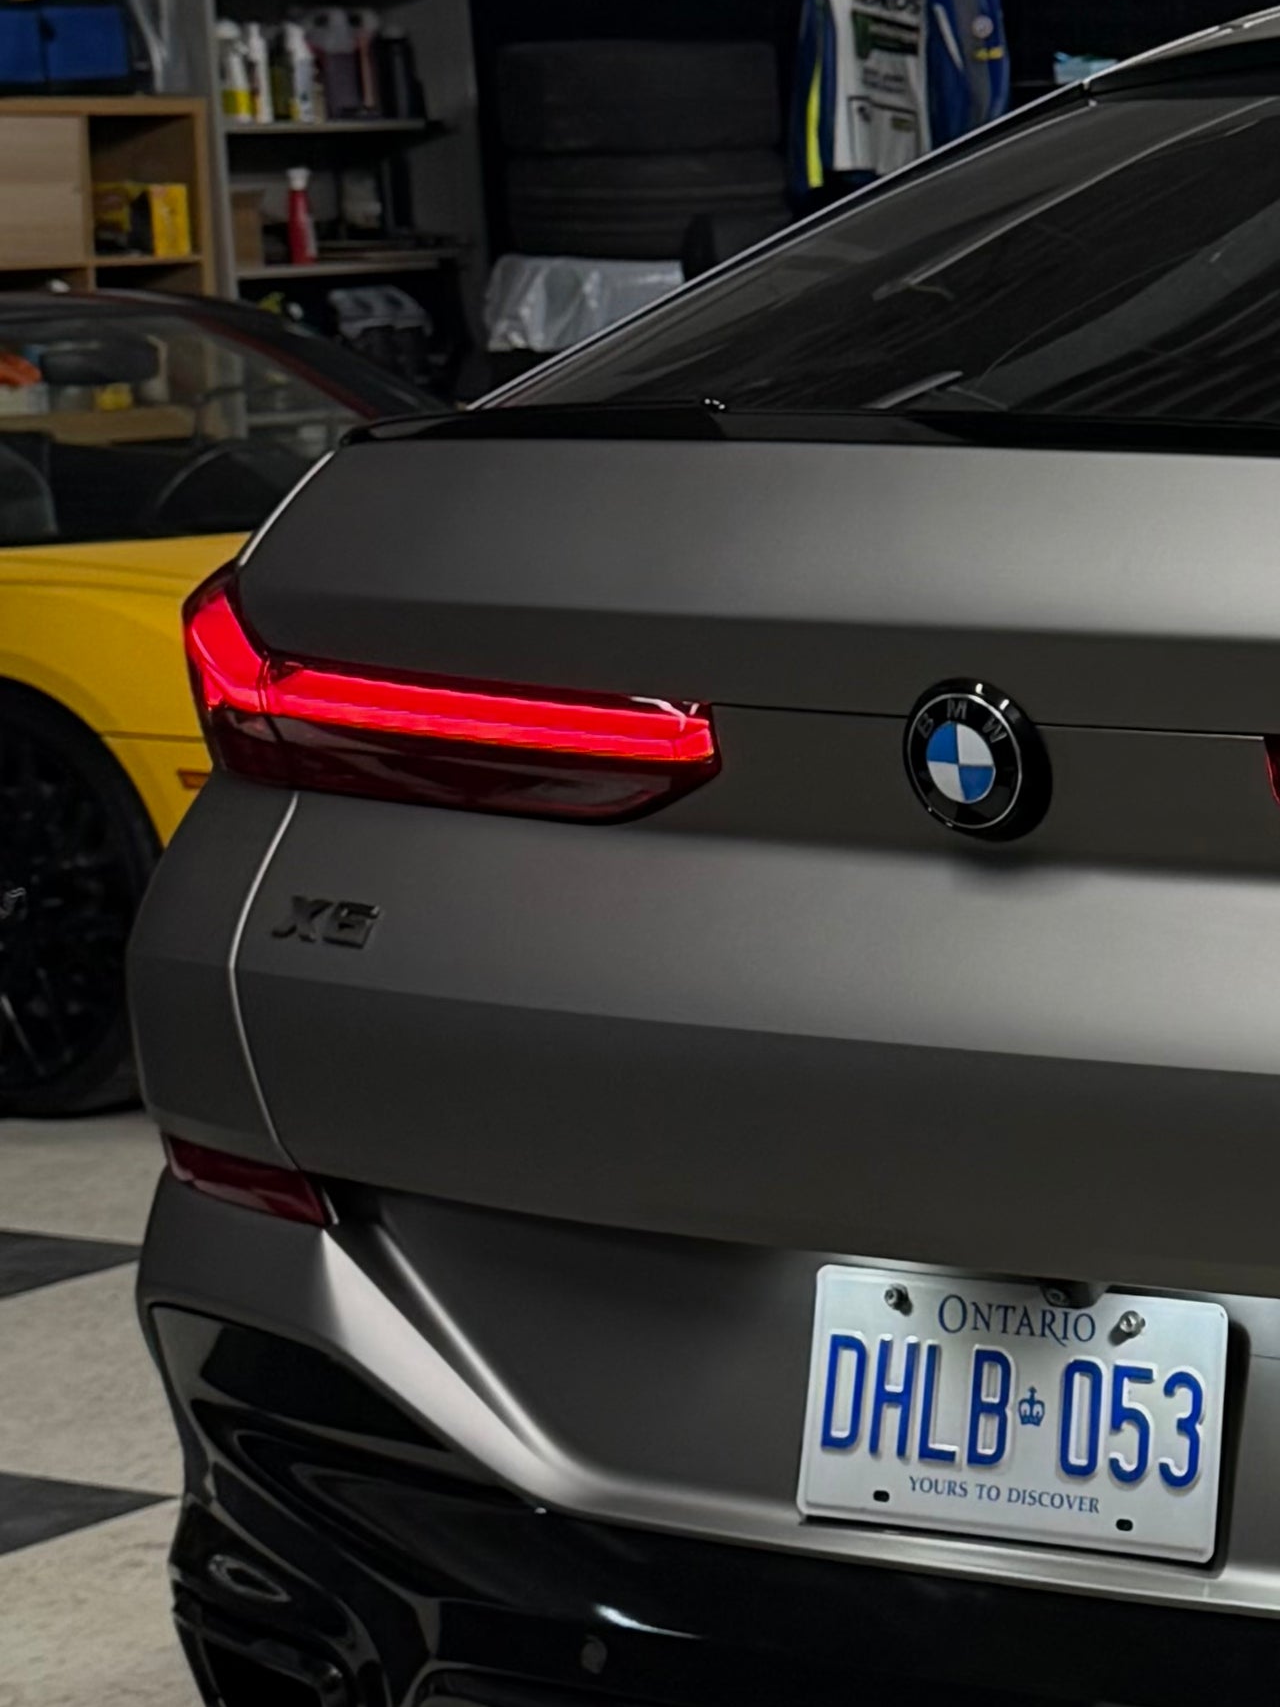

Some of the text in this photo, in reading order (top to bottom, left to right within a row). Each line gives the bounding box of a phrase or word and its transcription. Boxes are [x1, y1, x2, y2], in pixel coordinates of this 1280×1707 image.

[916, 699, 1007, 743] BMW
[938, 1294, 1097, 1346] ONTARIO
[821, 1333, 1204, 1488] DHLB 053
[909, 1475, 1100, 1514] YOURS TO DISCOVER
